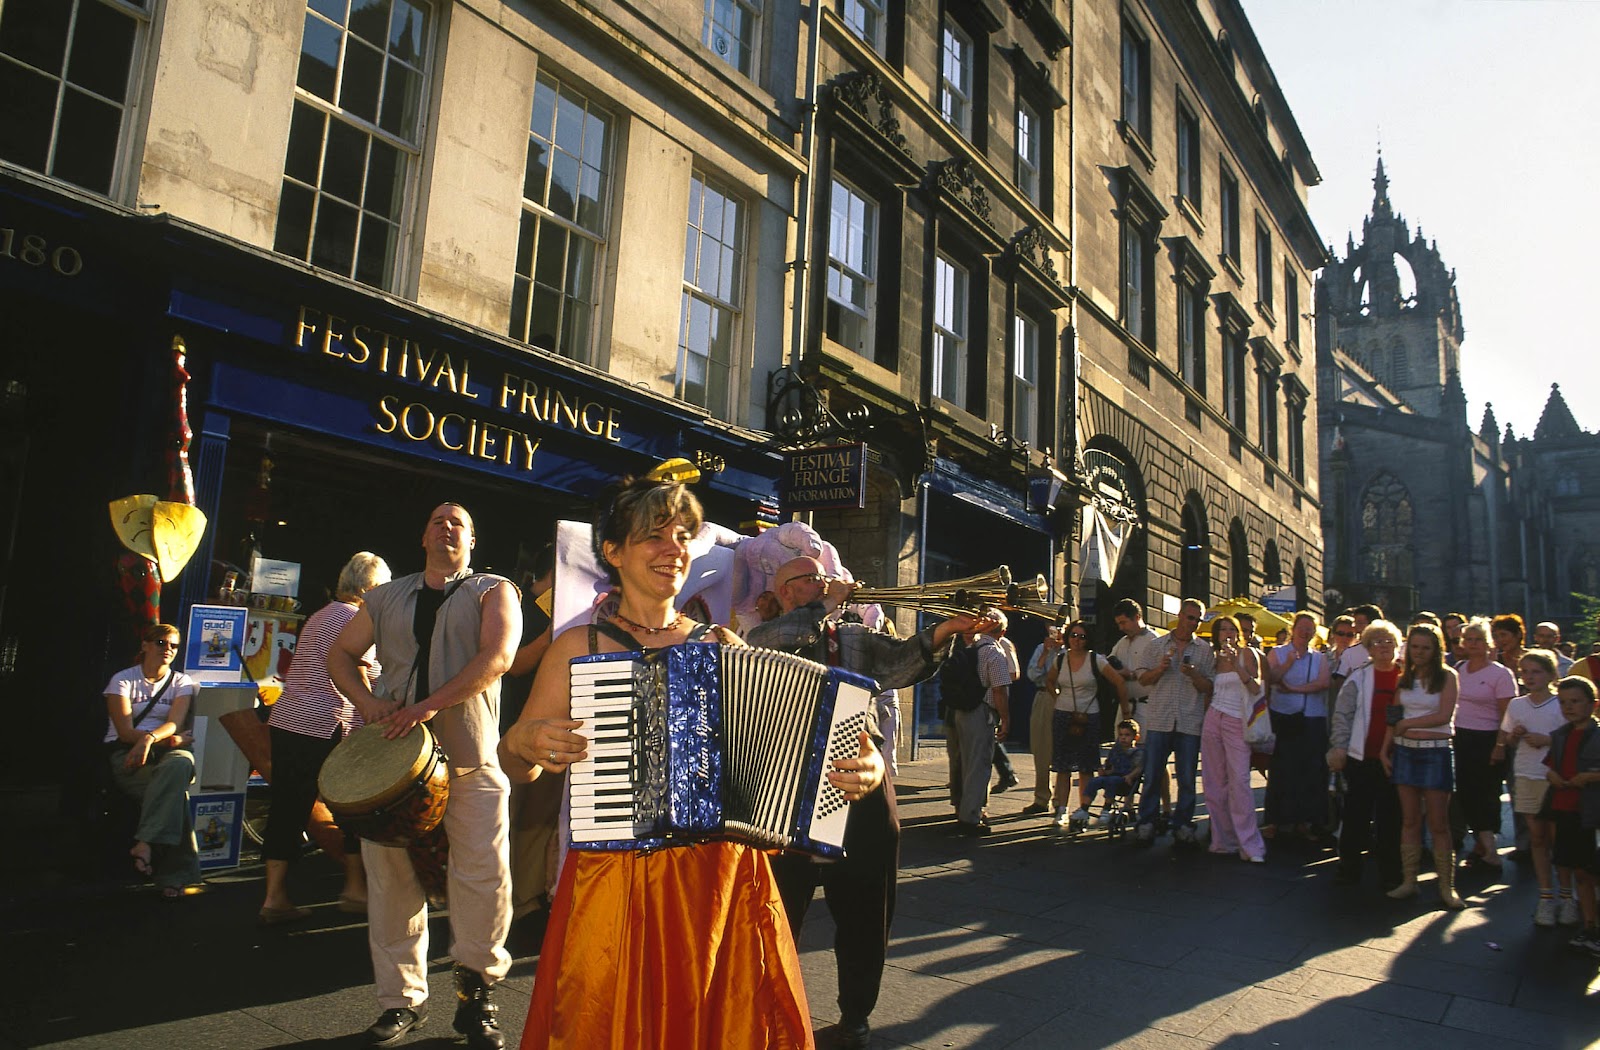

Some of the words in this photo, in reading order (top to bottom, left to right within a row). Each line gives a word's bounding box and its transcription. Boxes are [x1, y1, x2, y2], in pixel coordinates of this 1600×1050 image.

[0, 228, 83, 276] 180
[294, 304, 479, 399] FESTIVAL
[500, 372, 622, 443] FRINGE
[375, 394, 542, 471] SOCIETY
[695, 449, 726, 473] 180
[791, 451, 855, 472] FESTIVAL
[793, 467, 850, 487] FRINGE
[788, 486, 856, 502] INFORMATION
[696, 748, 710, 787] Main
